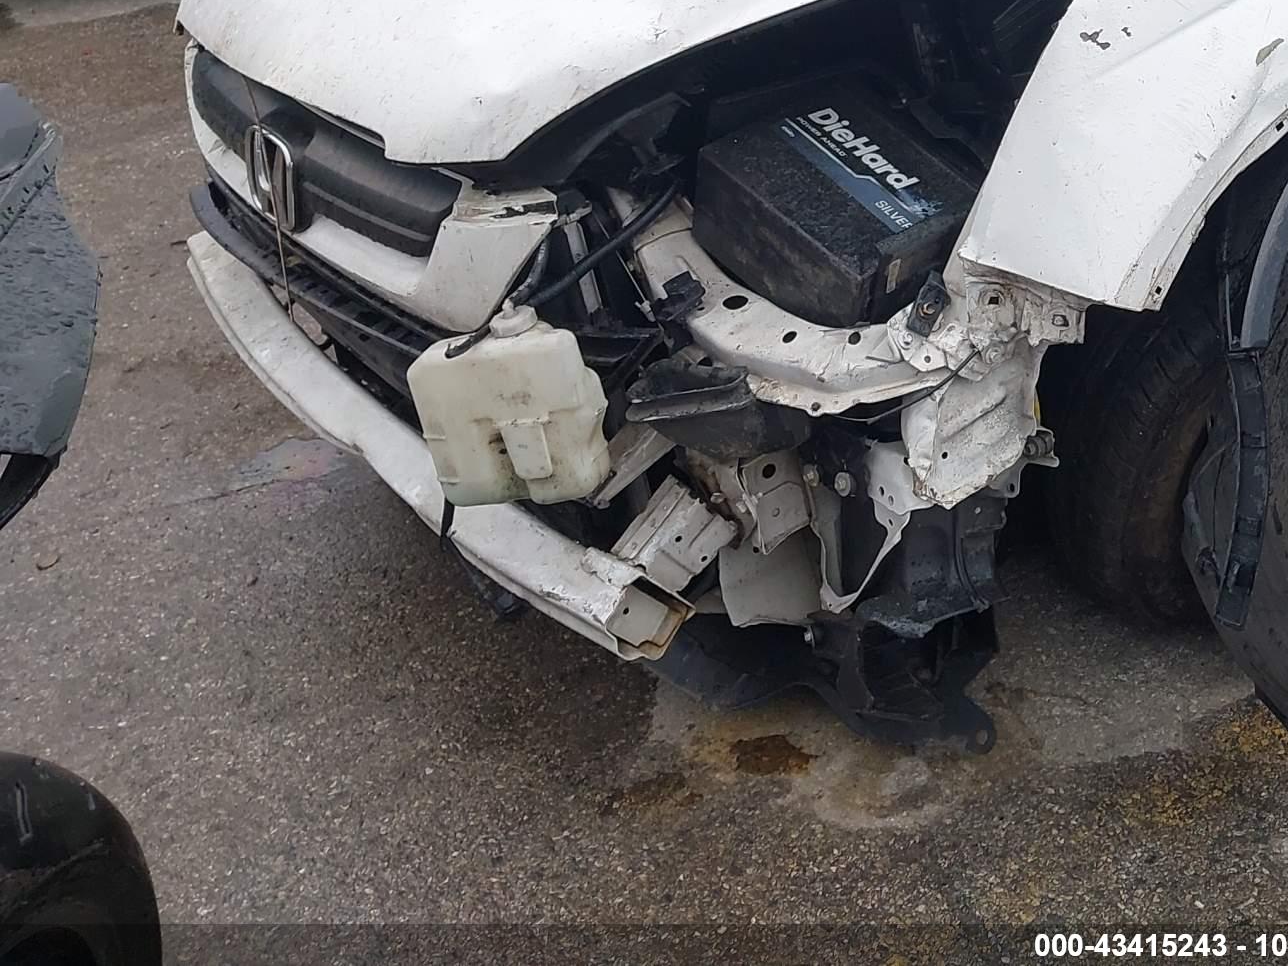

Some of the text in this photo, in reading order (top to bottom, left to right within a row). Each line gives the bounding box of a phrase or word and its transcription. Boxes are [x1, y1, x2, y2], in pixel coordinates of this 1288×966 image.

[796, 116, 822, 137] POWER
[820, 137, 847, 157] AHEAD
[808, 108, 920, 190] DieHard
